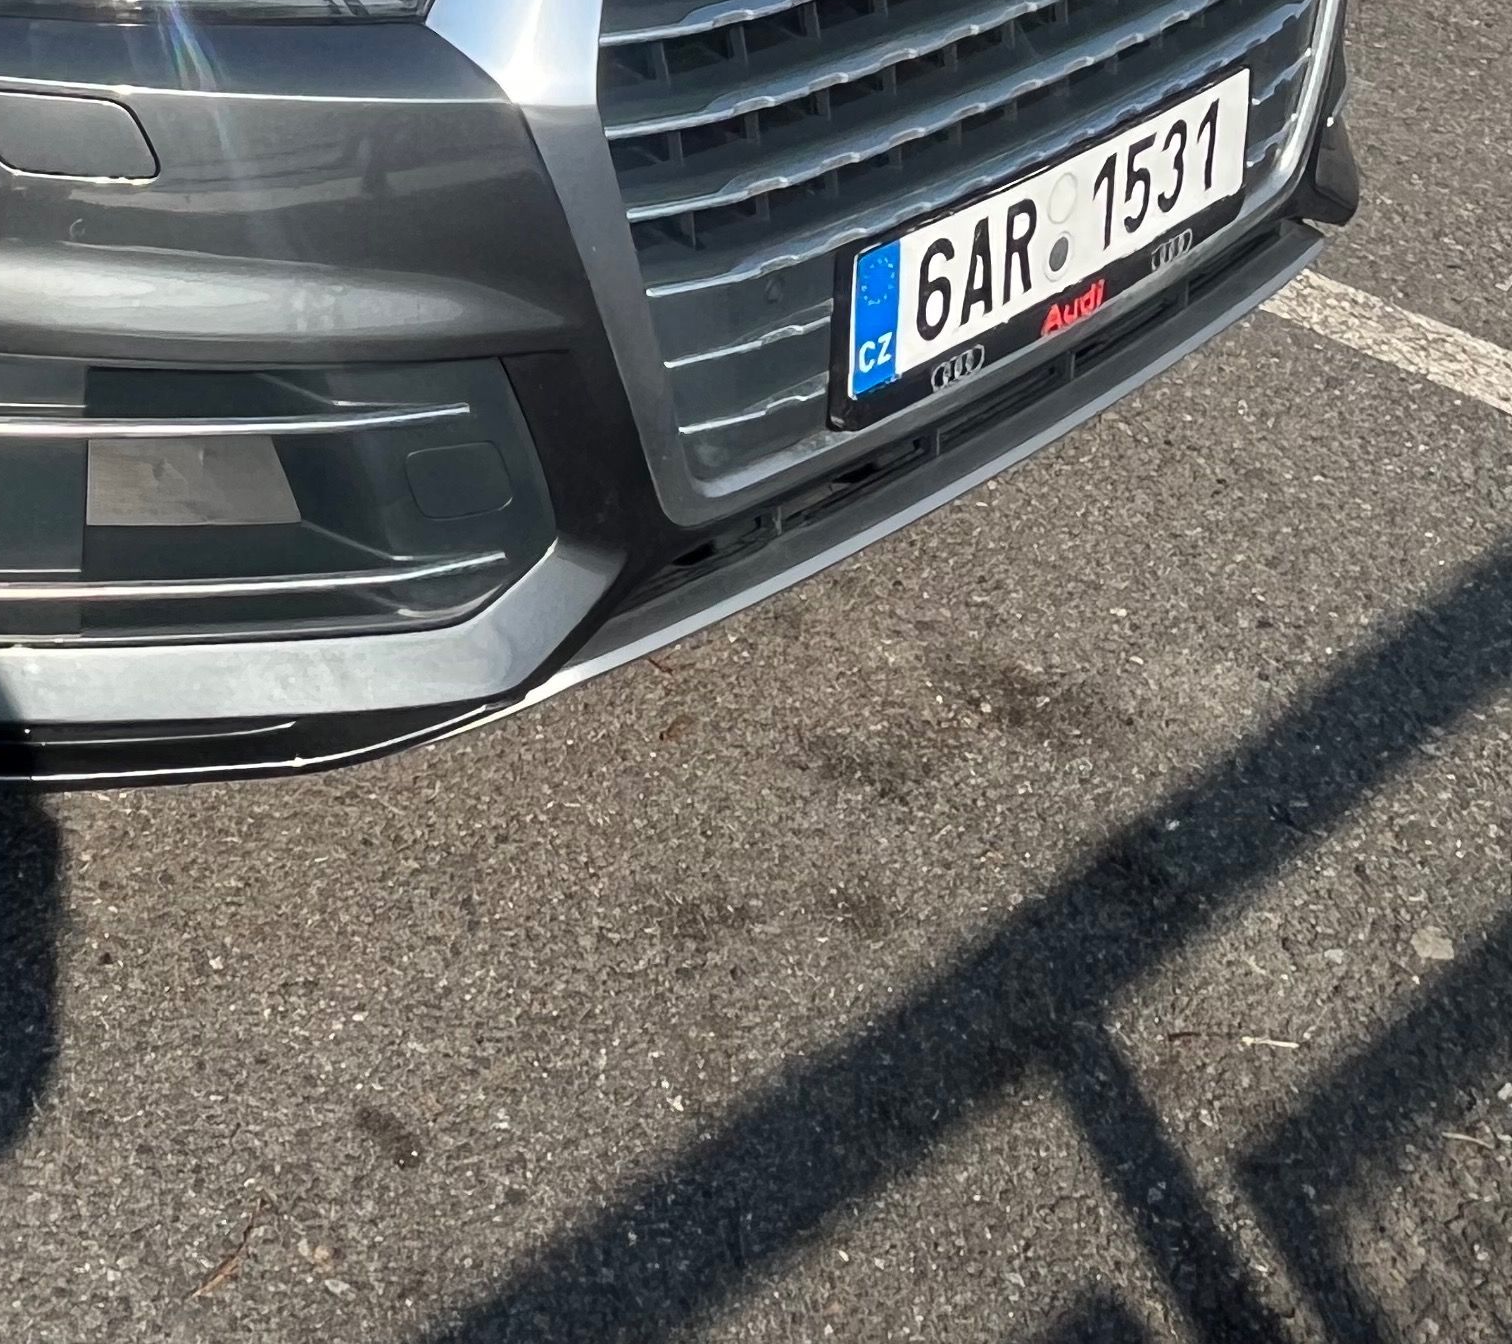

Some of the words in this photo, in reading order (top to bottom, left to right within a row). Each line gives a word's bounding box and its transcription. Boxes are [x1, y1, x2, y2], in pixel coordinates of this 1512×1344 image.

[916, 199, 1037, 340] 6AR
[1093, 98, 1219, 250] 1531
[1040, 278, 1106, 337] Audi
[858, 331, 892, 372] CZ
